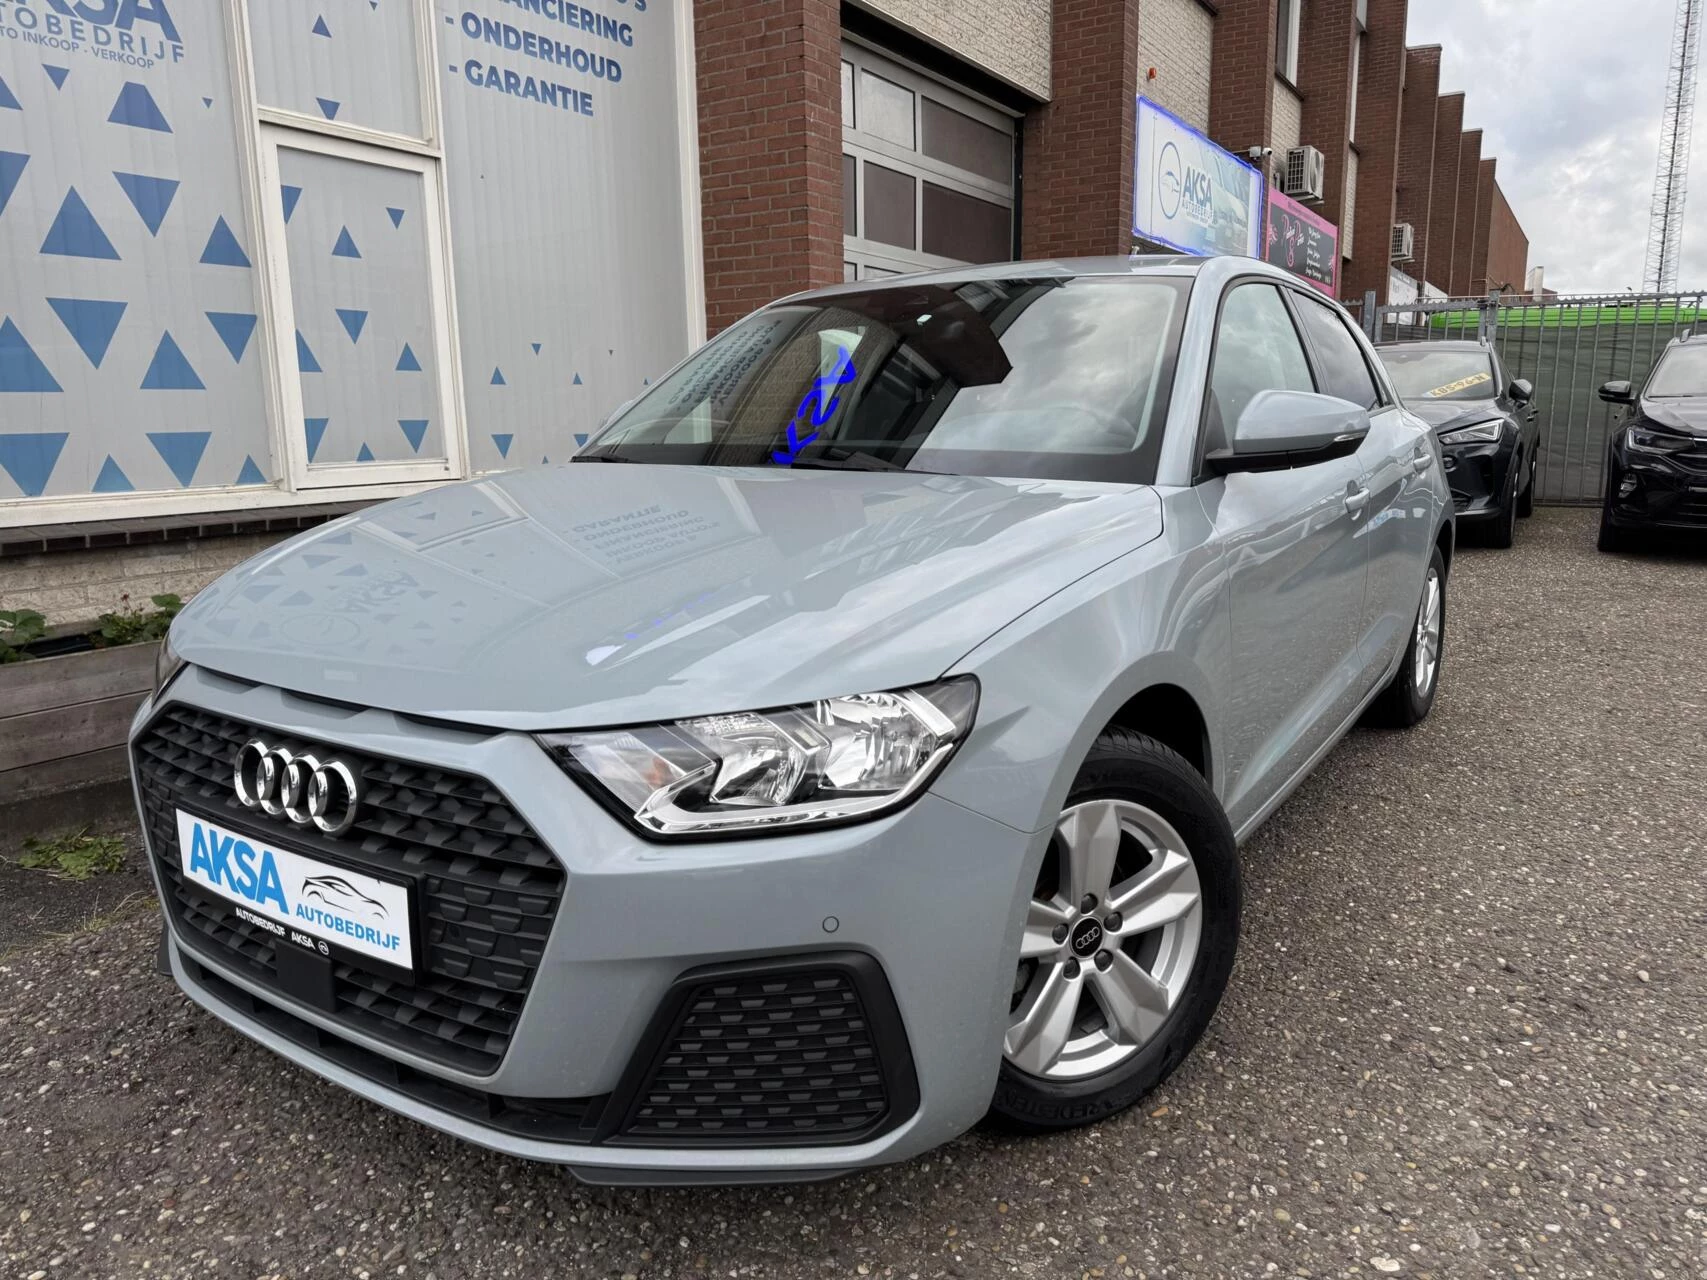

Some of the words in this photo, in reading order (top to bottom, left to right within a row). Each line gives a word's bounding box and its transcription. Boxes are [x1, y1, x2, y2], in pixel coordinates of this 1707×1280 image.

[23, 31, 80, 52] INKOOP
[91, 46, 155, 68] VERKOOP
[461, 12, 622, 83] ONDERHOUD
[465, 59, 594, 117] GARANTIE
[1182, 165, 1213, 211] AKSA
[1430, 374, 1487, 397] KBS-96-N
[190, 822, 289, 915] AKSA
[235, 907, 286, 937] AUTOBEDRIJF
[291, 932, 316, 951] AKSA
[296, 903, 400, 951] AUTOBEDRIJF
